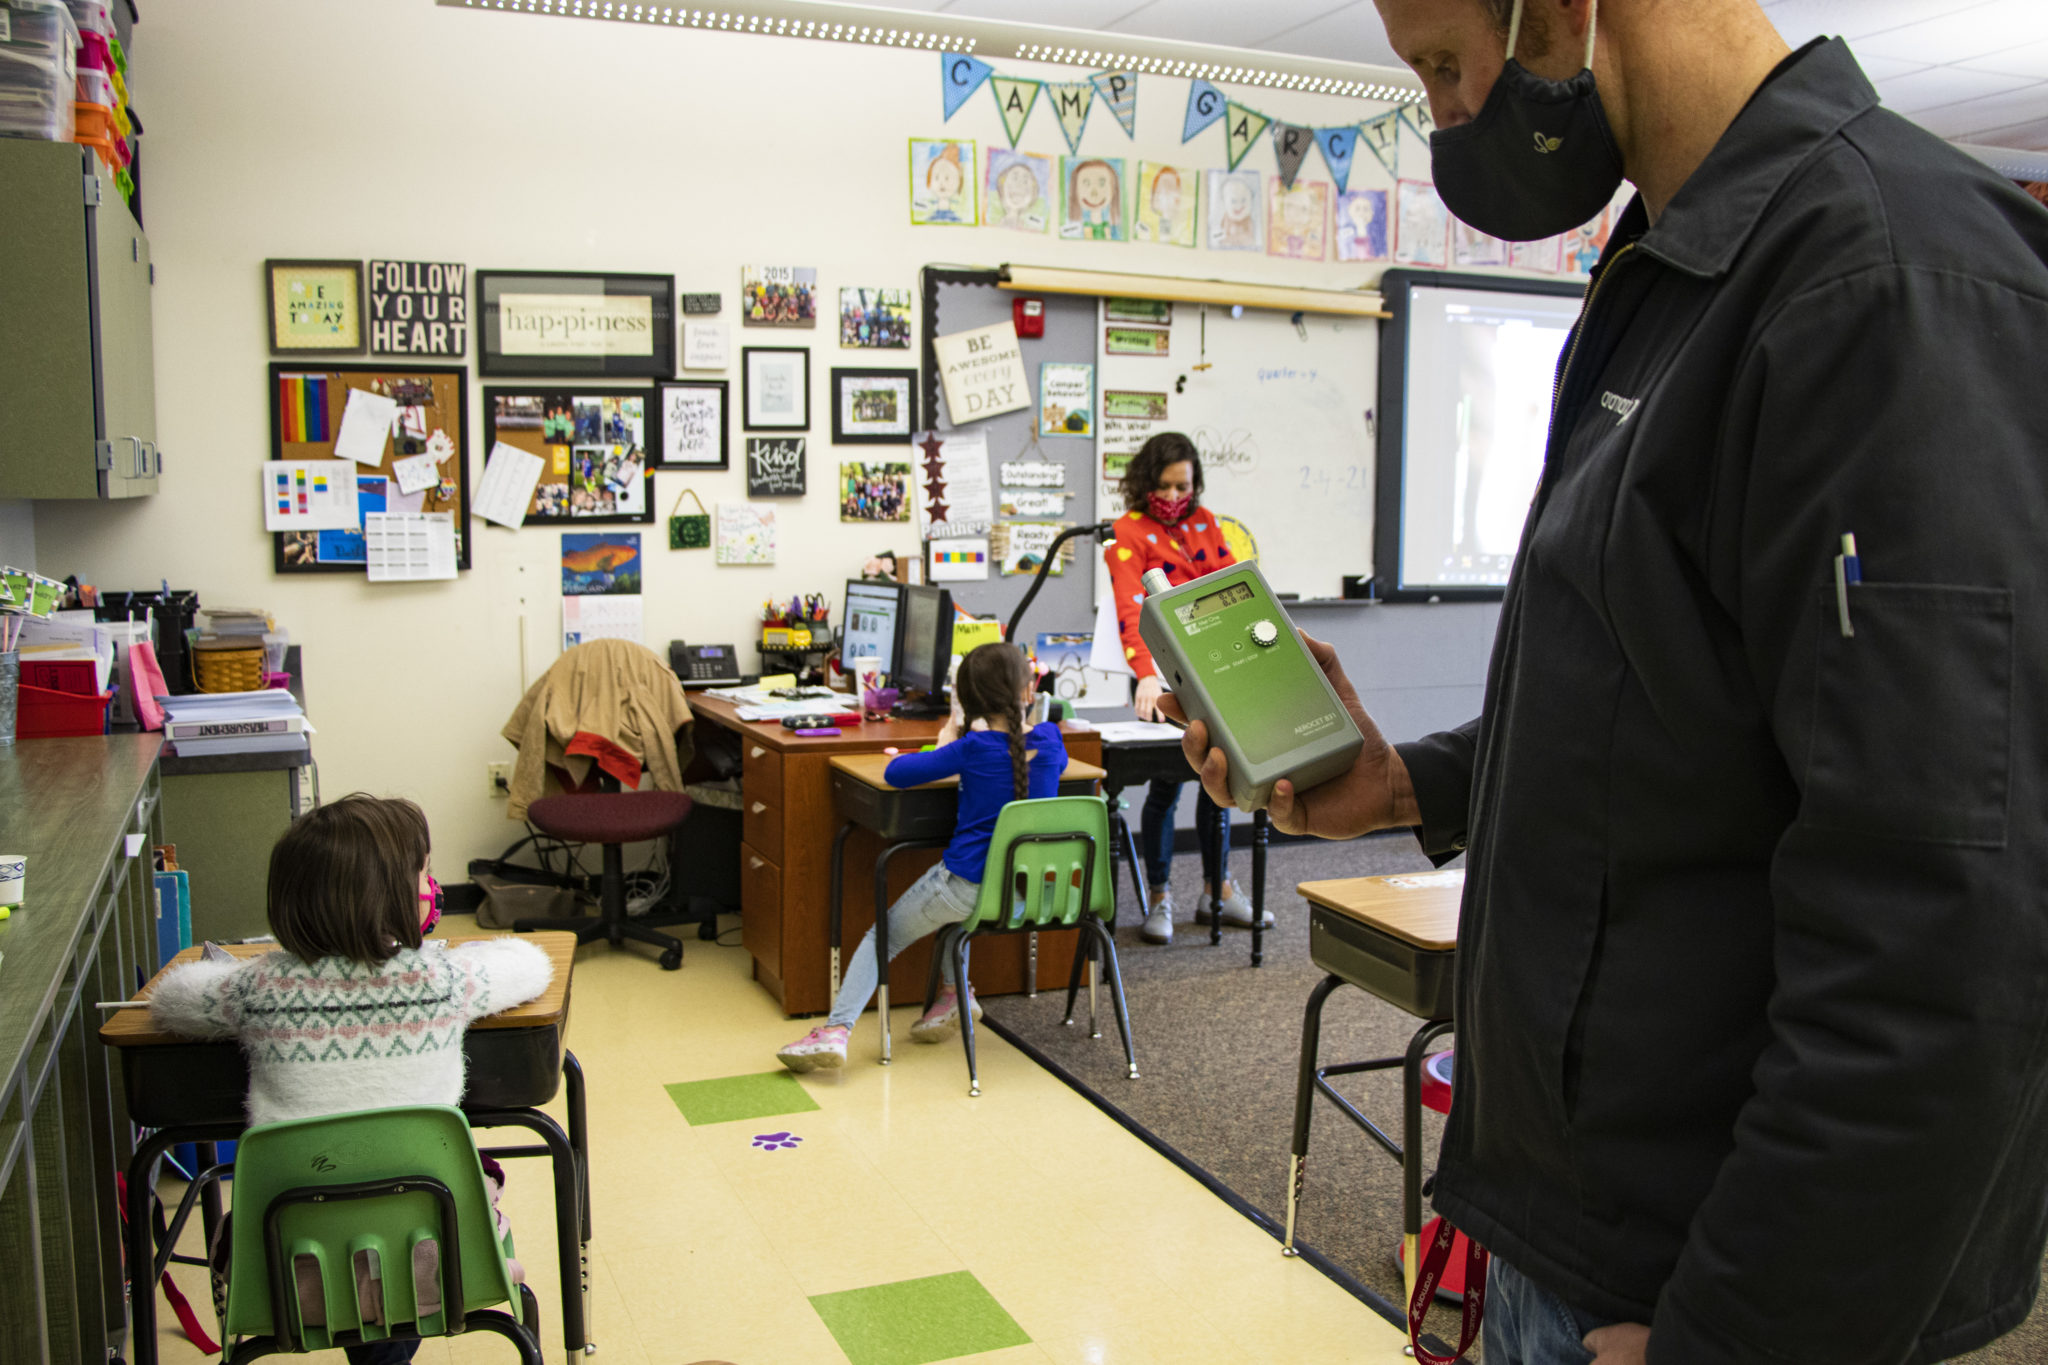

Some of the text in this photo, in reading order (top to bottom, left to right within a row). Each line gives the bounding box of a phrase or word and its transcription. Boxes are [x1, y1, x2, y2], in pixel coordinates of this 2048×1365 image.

[372, 261, 464, 295] FOLLOW
[764, 266, 790, 280] 2015
[289, 300, 345, 311] AMAZING
[372, 294, 465, 322] YOUR
[373, 319, 467, 354] HEART
[965, 333, 993, 355] BE
[948, 349, 1020, 375] AWESOME
[965, 382, 1016, 414] DAY
[922, 520, 993, 540] Panthers
[1017, 529, 1050, 541] Ready
[199, 720, 270, 737] MEASUREMENT
[1416, 1271, 1434, 1309] aramark
